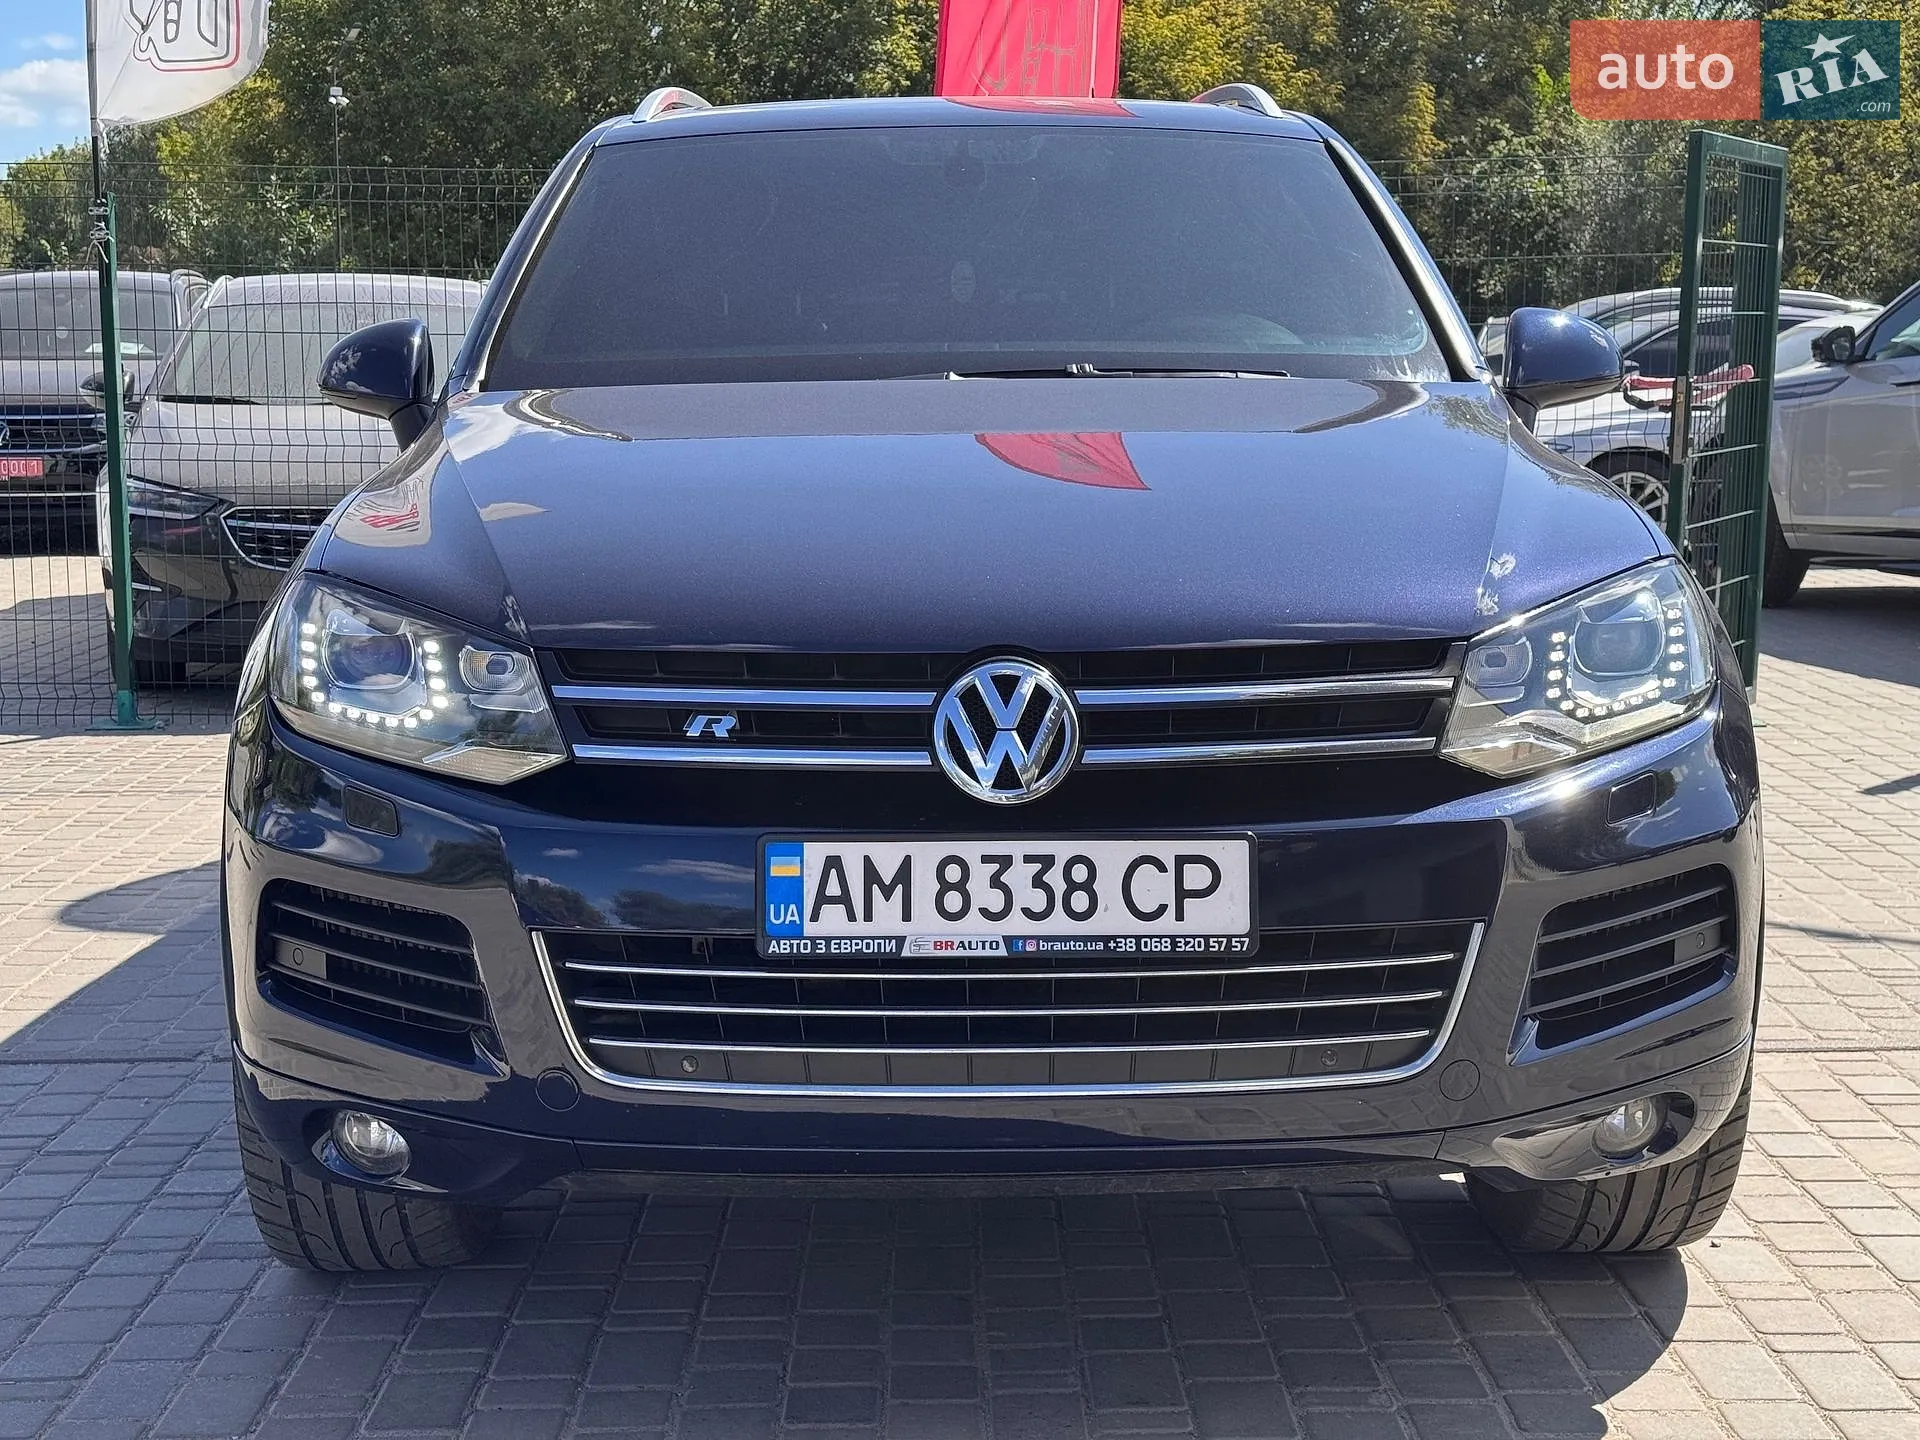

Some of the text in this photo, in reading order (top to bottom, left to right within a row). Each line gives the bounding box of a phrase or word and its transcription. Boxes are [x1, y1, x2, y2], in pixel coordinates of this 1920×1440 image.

[683, 711, 740, 739] R
[809, 854, 1222, 923] AM 8338 CP
[769, 904, 801, 925] UA
[768, 939, 811, 954] АВТО
[933, 940, 1000, 951] BRAUTO
[1039, 939, 1104, 951] brauto.ua
[1107, 938, 1137, 952] +38
[1140, 938, 1171, 952] 068
[1175, 938, 1205, 952] 320
[1209, 938, 1228, 952] 57
[1231, 938, 1250, 952] 57
